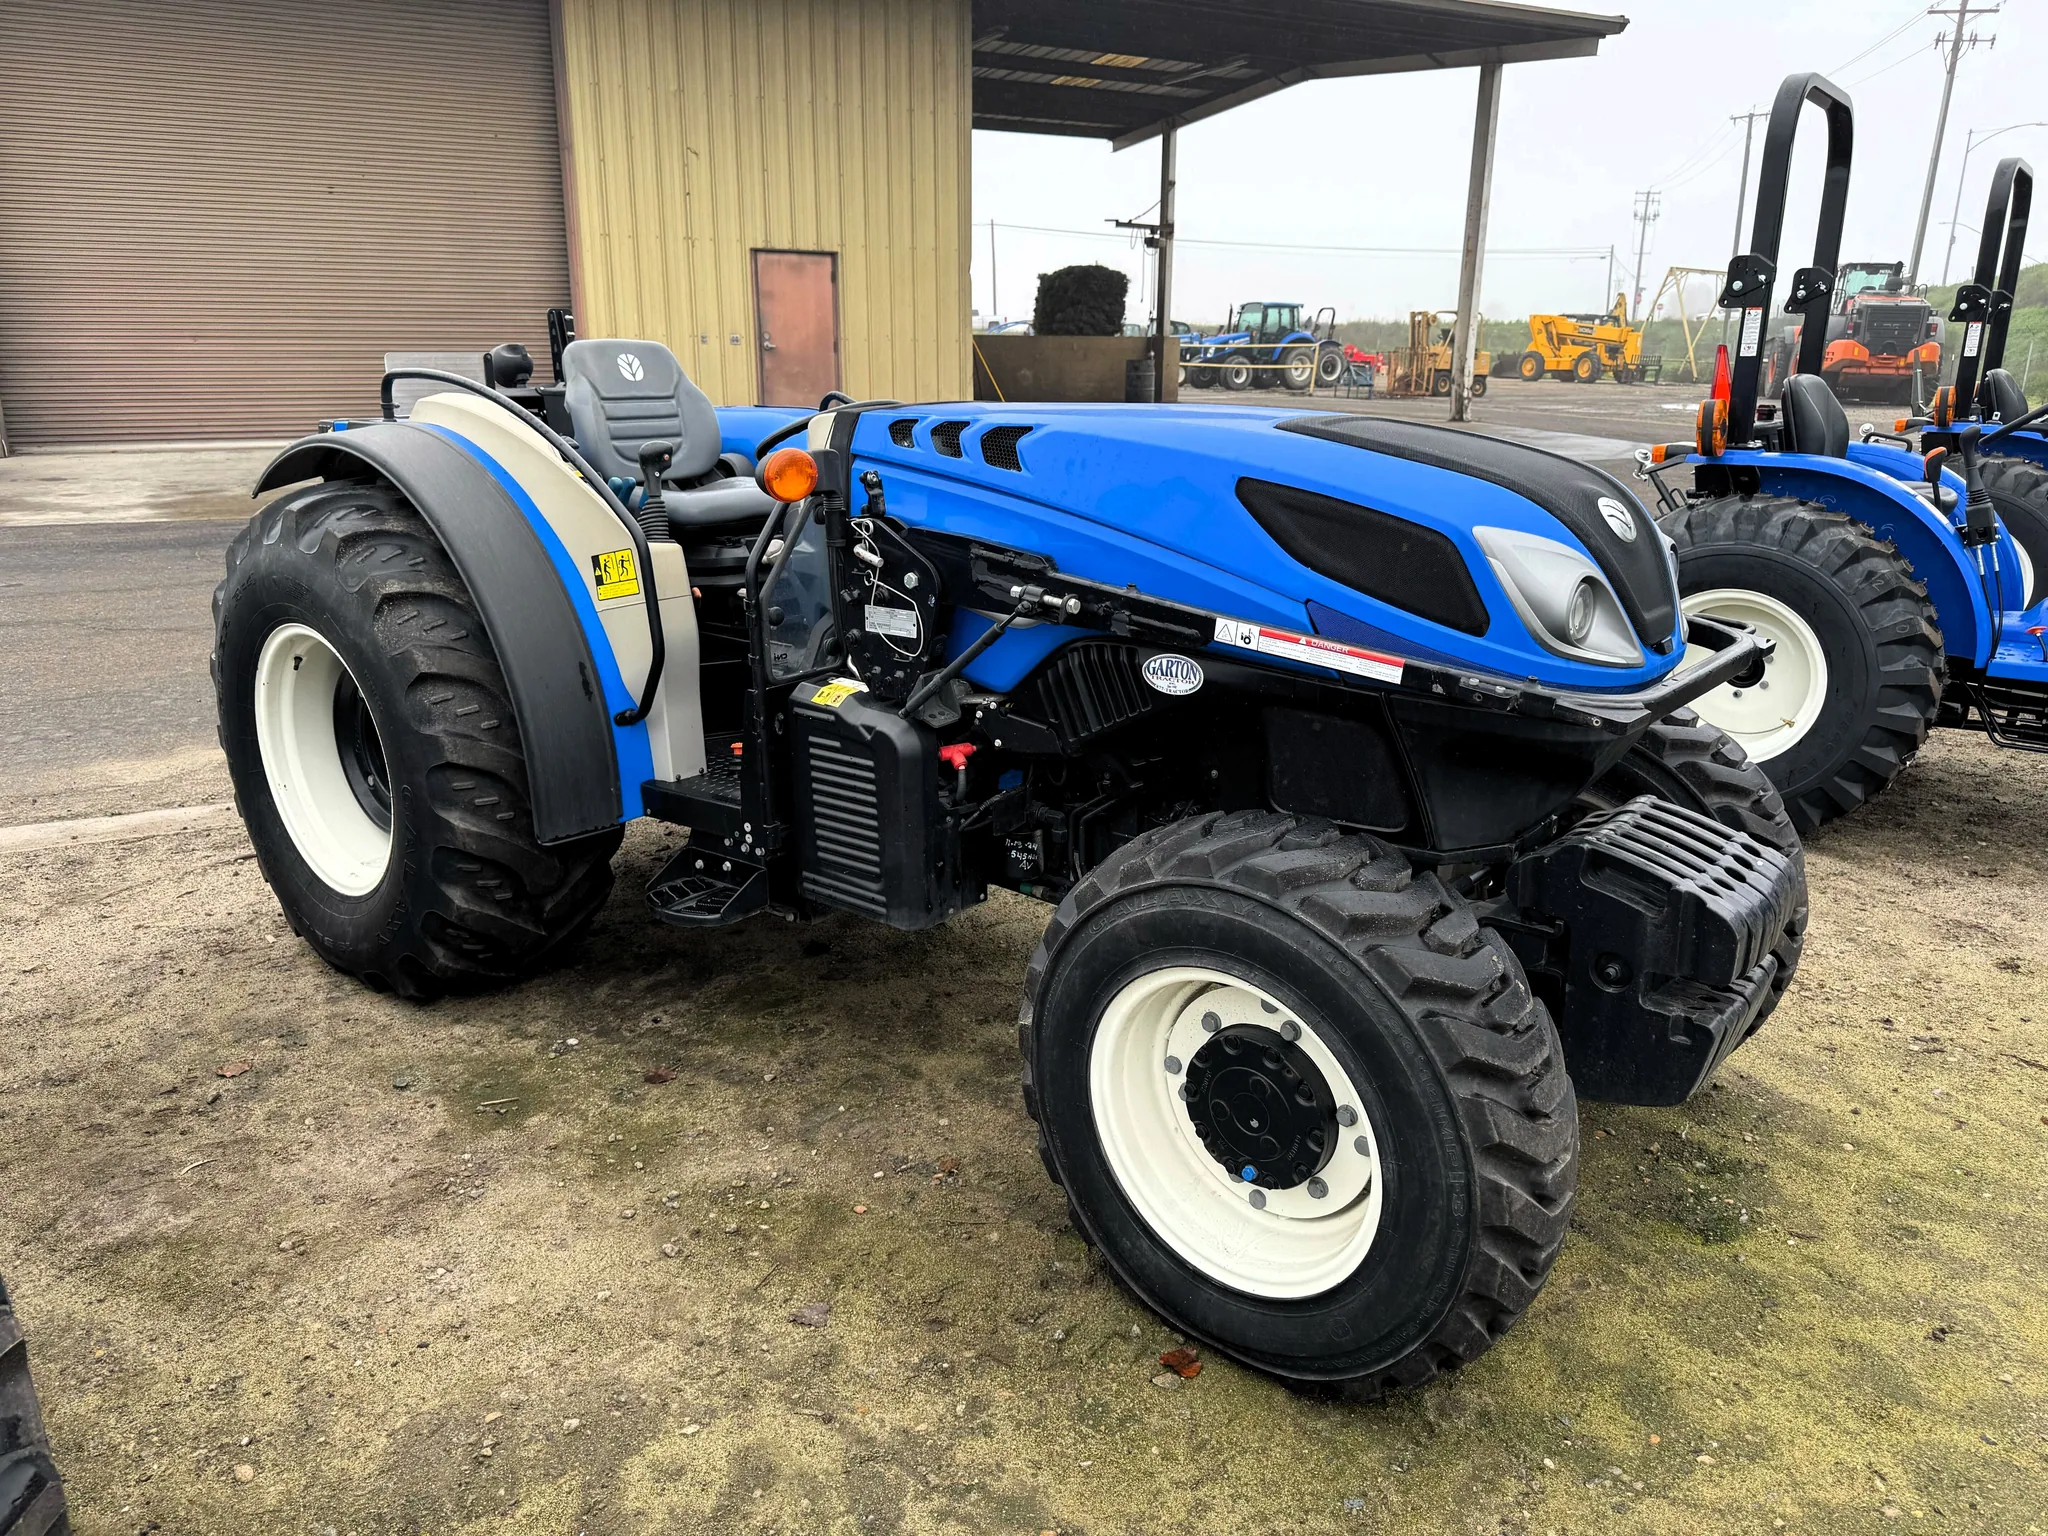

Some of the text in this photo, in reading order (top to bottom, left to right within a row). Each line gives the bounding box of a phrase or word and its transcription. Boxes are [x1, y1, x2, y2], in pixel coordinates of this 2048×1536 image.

[1310, 640, 1350, 654] DANGER
[1147, 659, 1199, 681] GARTON
[1150, 674, 1195, 685] TRACTOR
[1088, 887, 1257, 934] GALAXY
